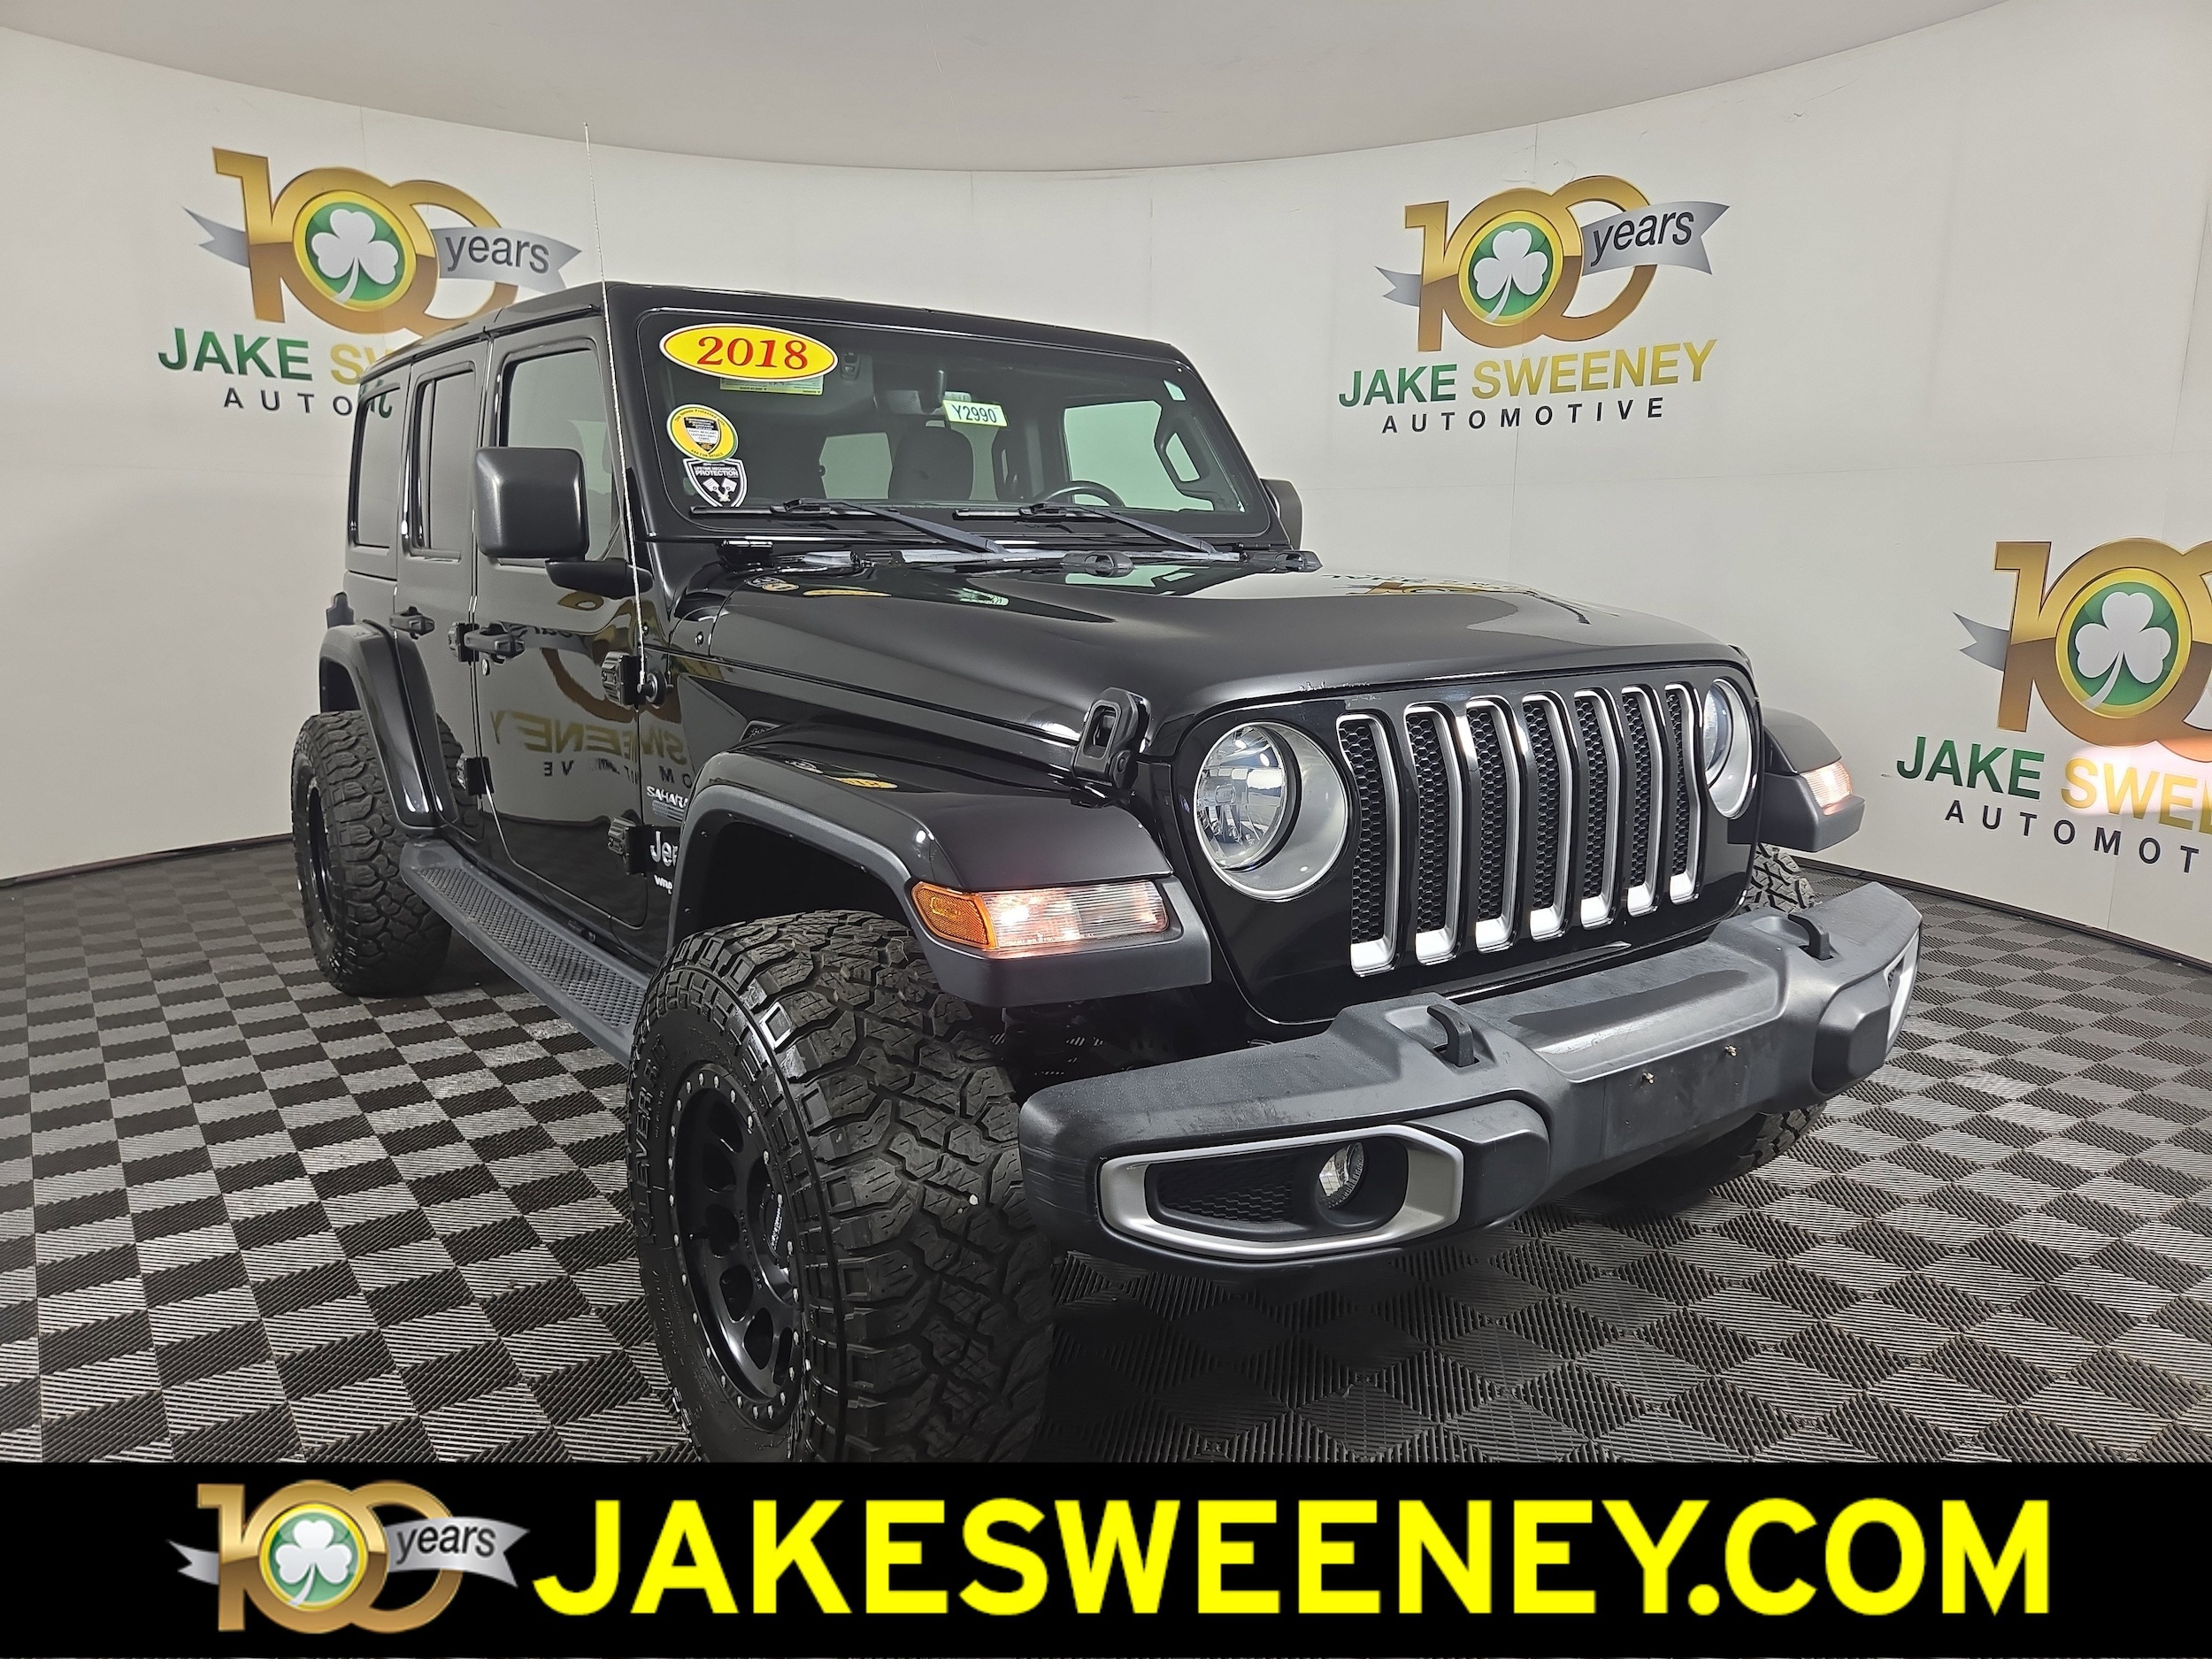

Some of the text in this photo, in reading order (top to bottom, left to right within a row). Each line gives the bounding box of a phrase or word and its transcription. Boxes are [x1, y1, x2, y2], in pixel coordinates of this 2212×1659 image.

[212, 147, 551, 337] 100 years
[1405, 175, 1694, 351] 100 years
[158, 327, 313, 380] JAKE
[697, 336, 809, 370] 2018
[1339, 339, 1717, 407] JAKE SWEENEY
[951, 403, 997, 423] Y2990
[1381, 397, 1663, 434] AUTOMOTIVE
[1896, 736, 2212, 835] JAKE SWE
[1945, 800, 2200, 873] AUTOMOT
[634, 1087, 655, 1245] KLEVER
